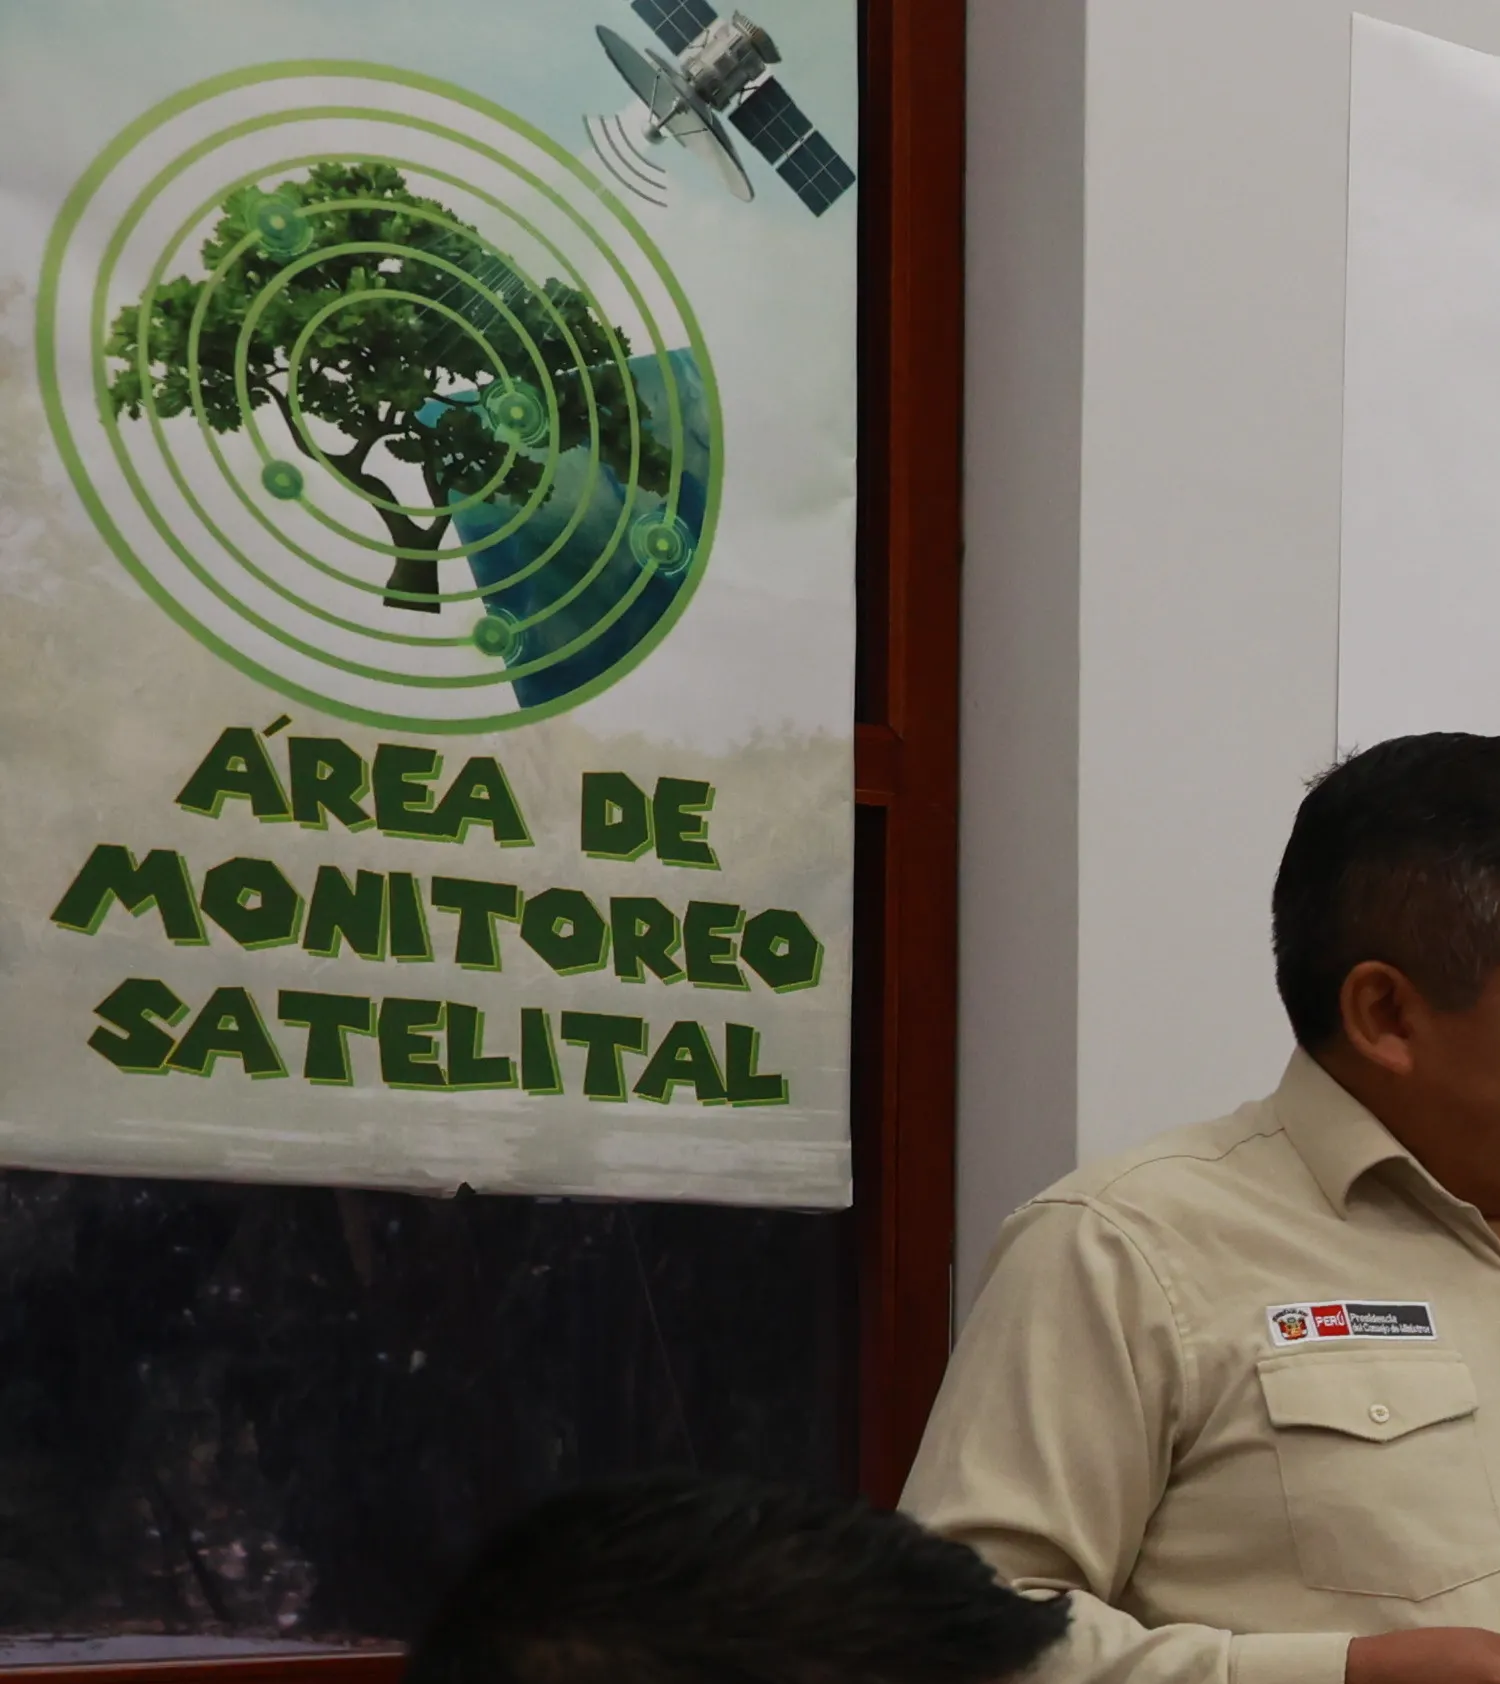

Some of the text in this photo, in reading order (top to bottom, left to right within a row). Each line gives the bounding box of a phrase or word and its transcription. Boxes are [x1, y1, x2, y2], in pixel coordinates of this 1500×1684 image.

[177, 714, 721, 870] ÁREA DE
[50, 843, 824, 992] MONITOREO
[87, 977, 789, 1106] SATELITAL
[1315, 1310, 1346, 1327] PERÚ
